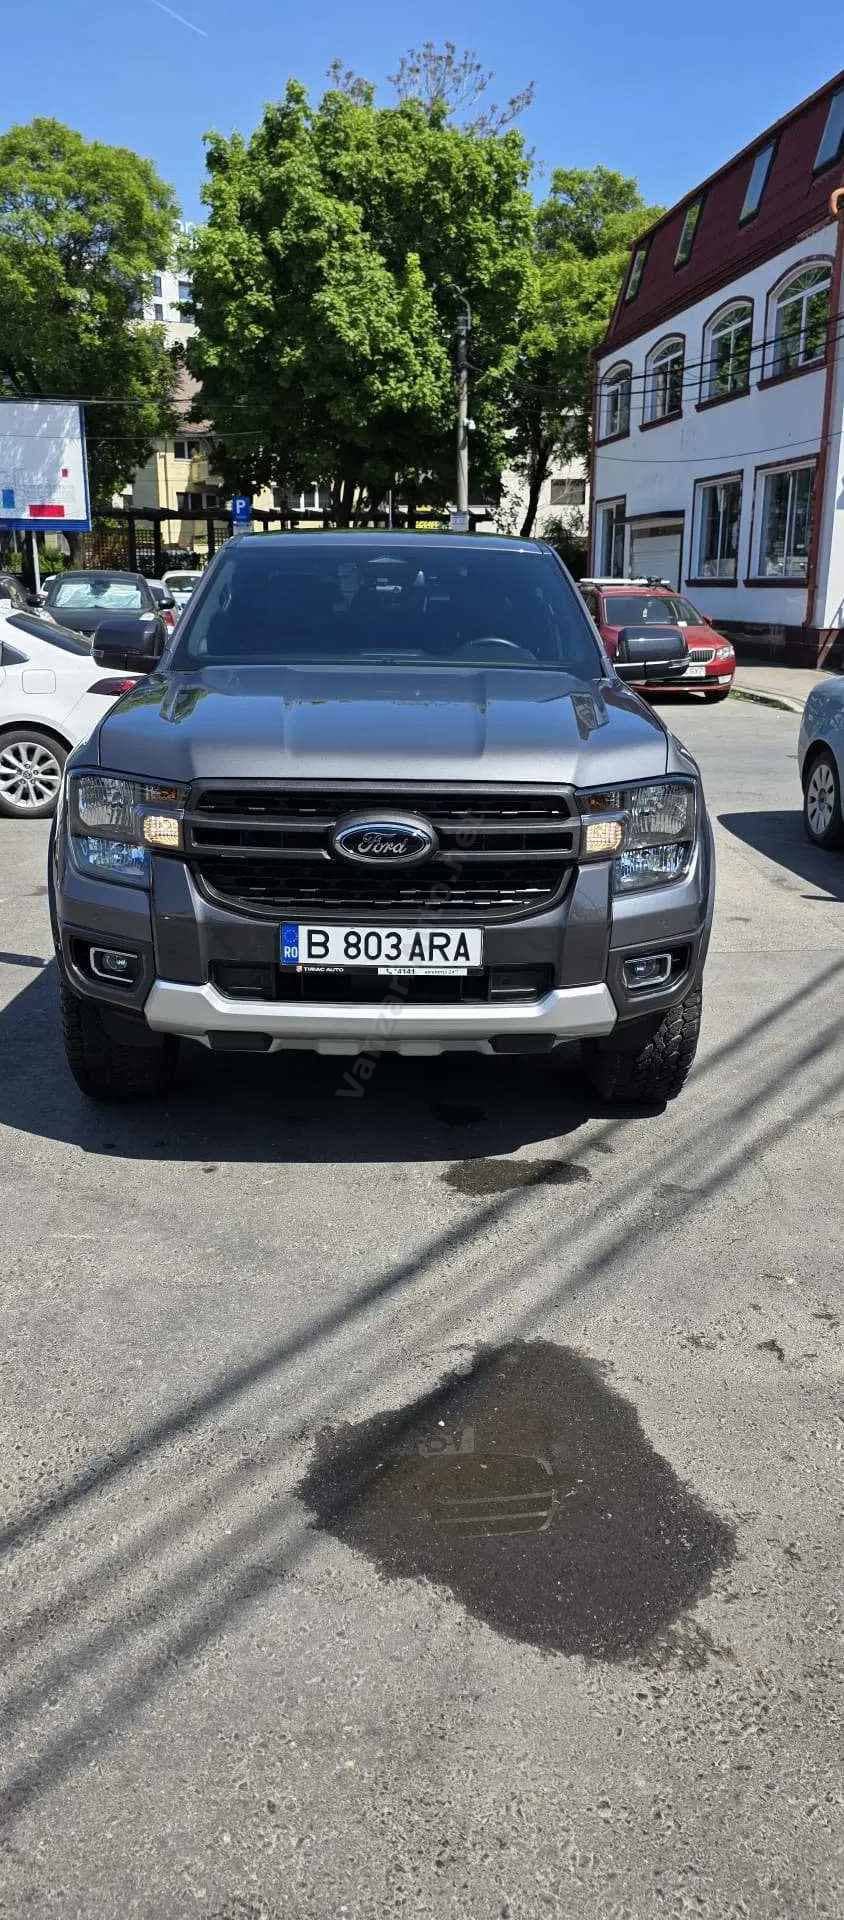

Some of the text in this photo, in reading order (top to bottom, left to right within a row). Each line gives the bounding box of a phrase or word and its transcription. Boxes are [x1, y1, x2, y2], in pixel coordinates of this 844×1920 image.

[236, 499, 246, 514] P
[357, 832, 408, 853] Ford
[284, 946, 298, 958] RO
[307, 929, 470, 961] B 803 ARA
